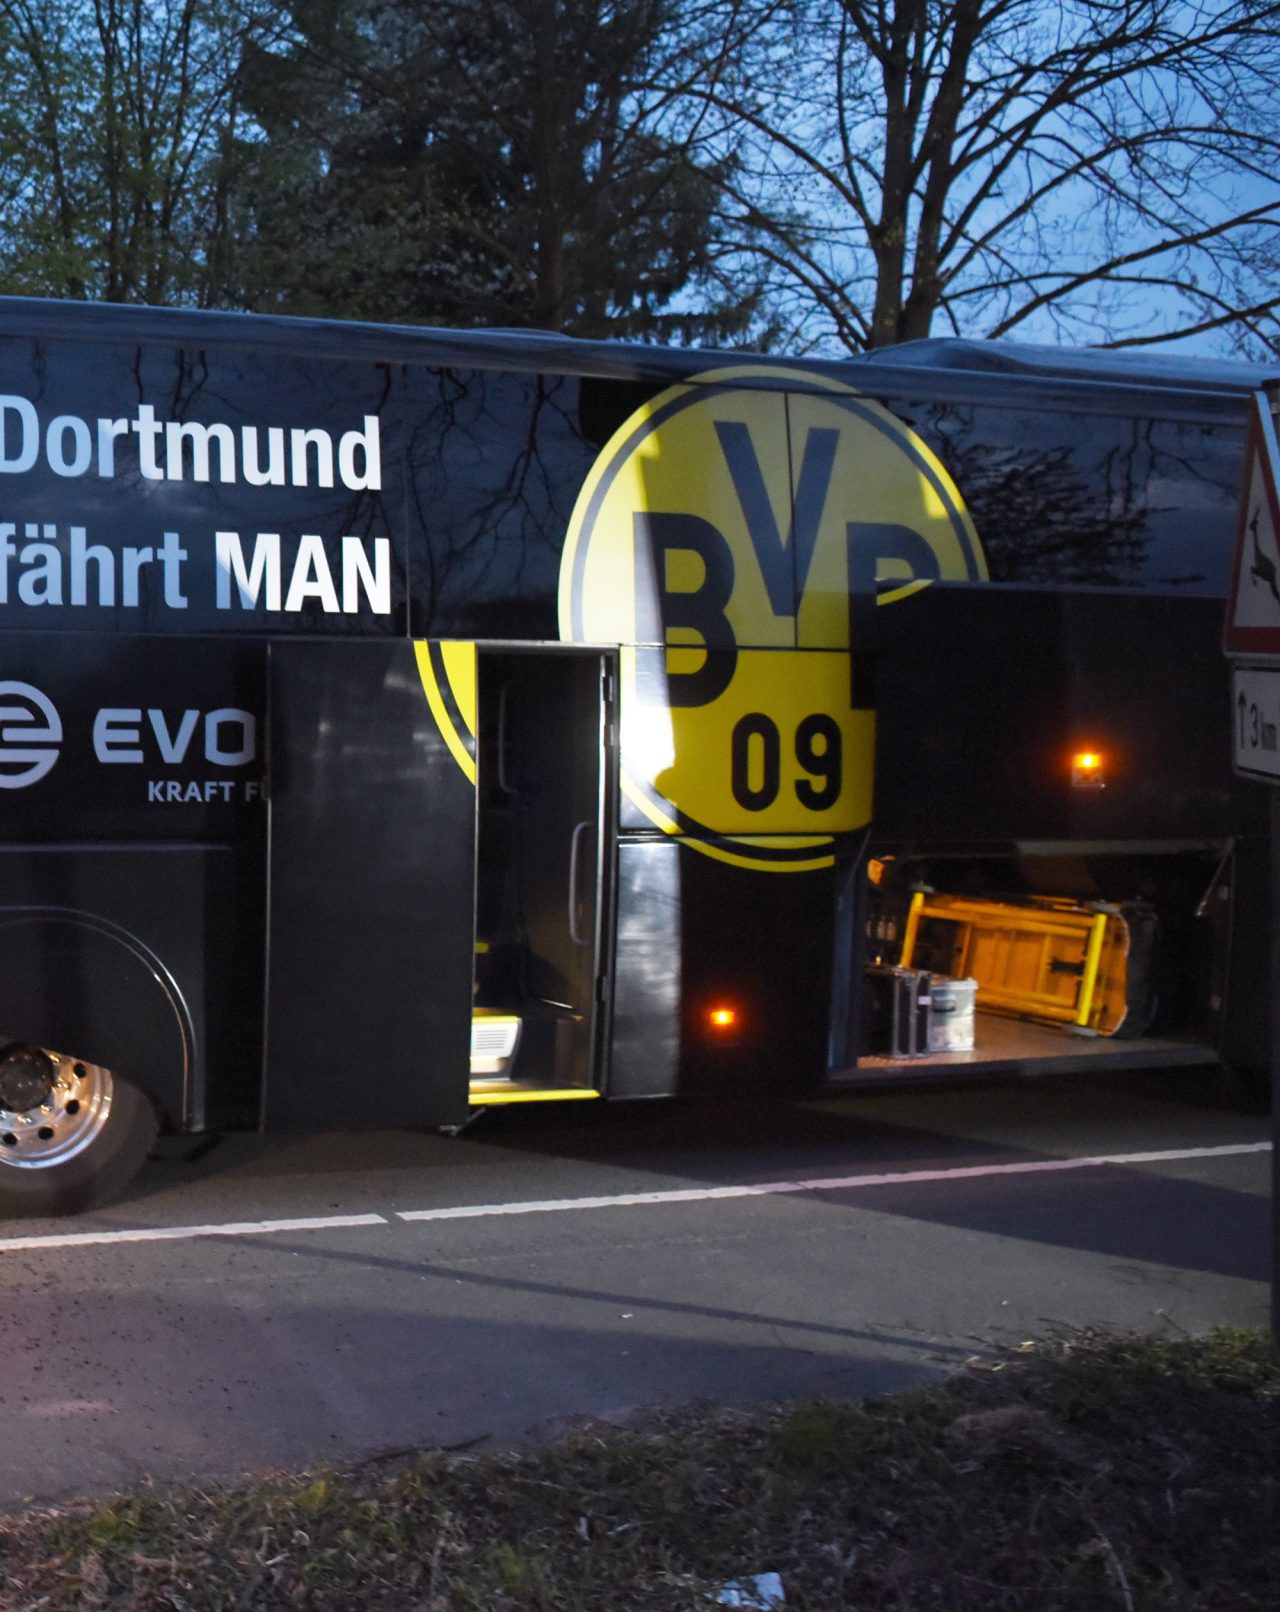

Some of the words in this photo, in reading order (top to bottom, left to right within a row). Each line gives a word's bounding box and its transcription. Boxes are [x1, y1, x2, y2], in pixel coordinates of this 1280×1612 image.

[215, 531, 392, 615] MAN
[93, 708, 256, 766] EVO
[731, 712, 843, 812] 09
[148, 780, 235, 802] KRAFT
